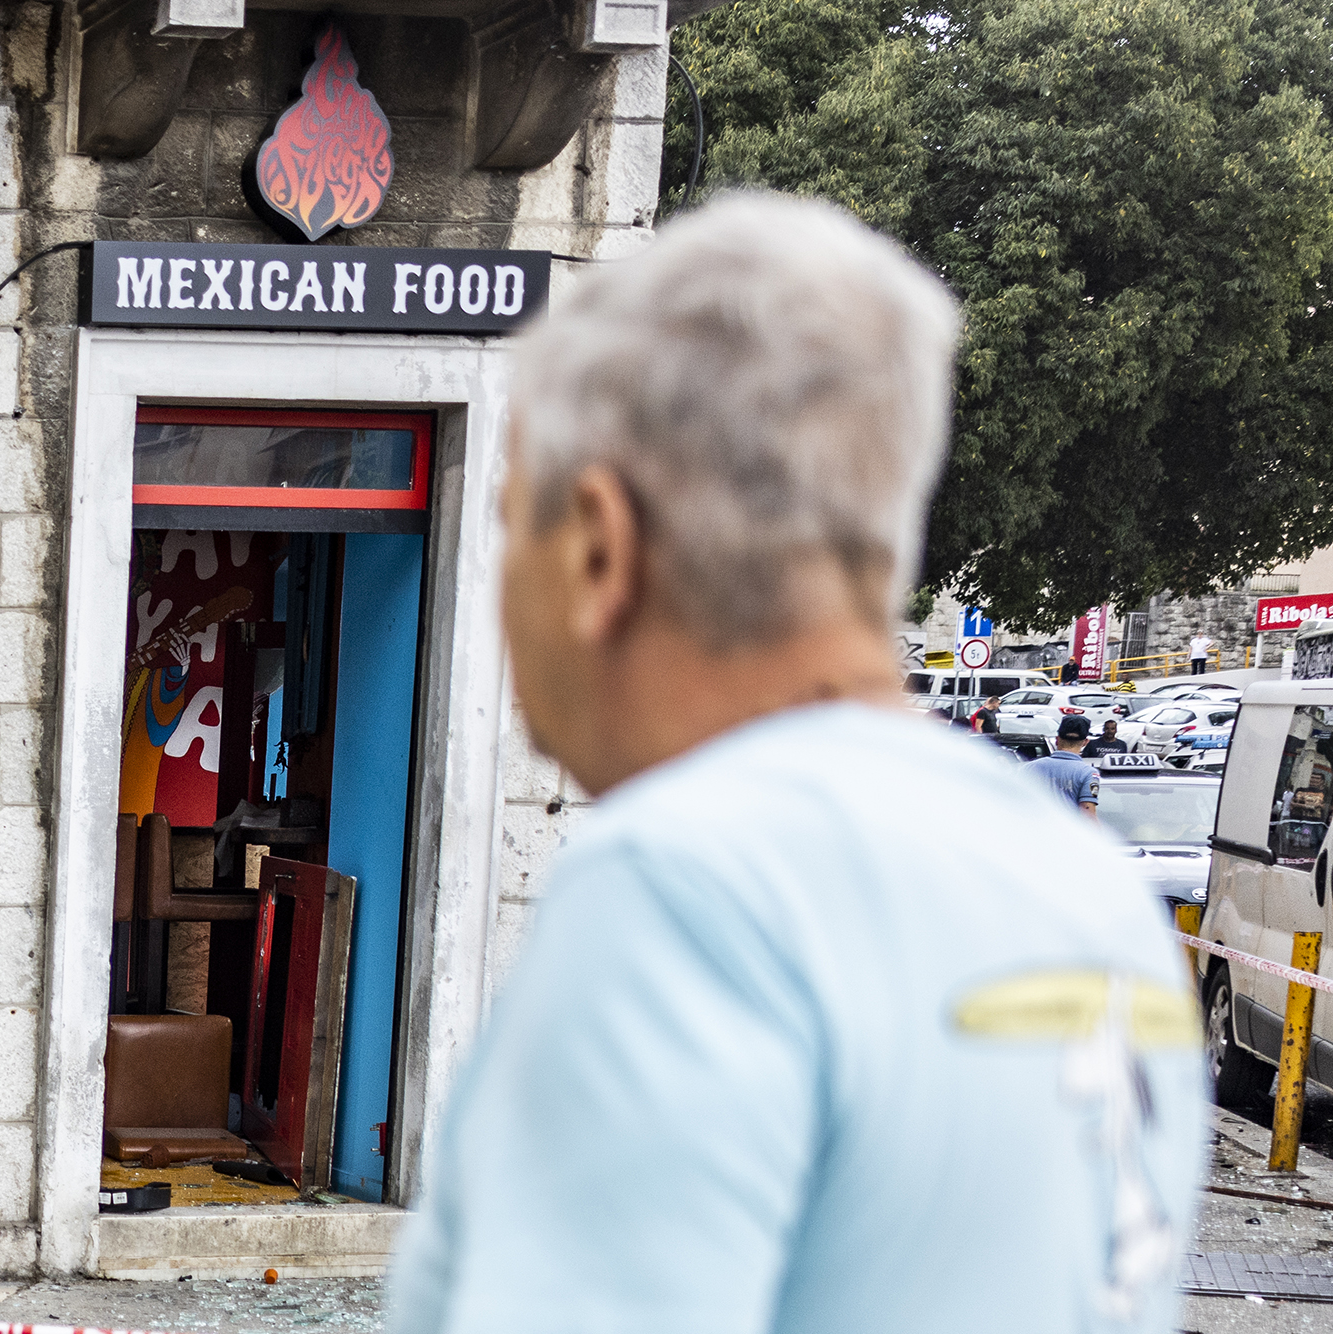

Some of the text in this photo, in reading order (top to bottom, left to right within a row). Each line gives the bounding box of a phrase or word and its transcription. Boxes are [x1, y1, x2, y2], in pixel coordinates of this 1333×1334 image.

[115, 256, 525, 316] MEXICAN FOOD
[1268, 603, 1328, 624] Ribola
[1111, 755, 1154, 766] TAXI
